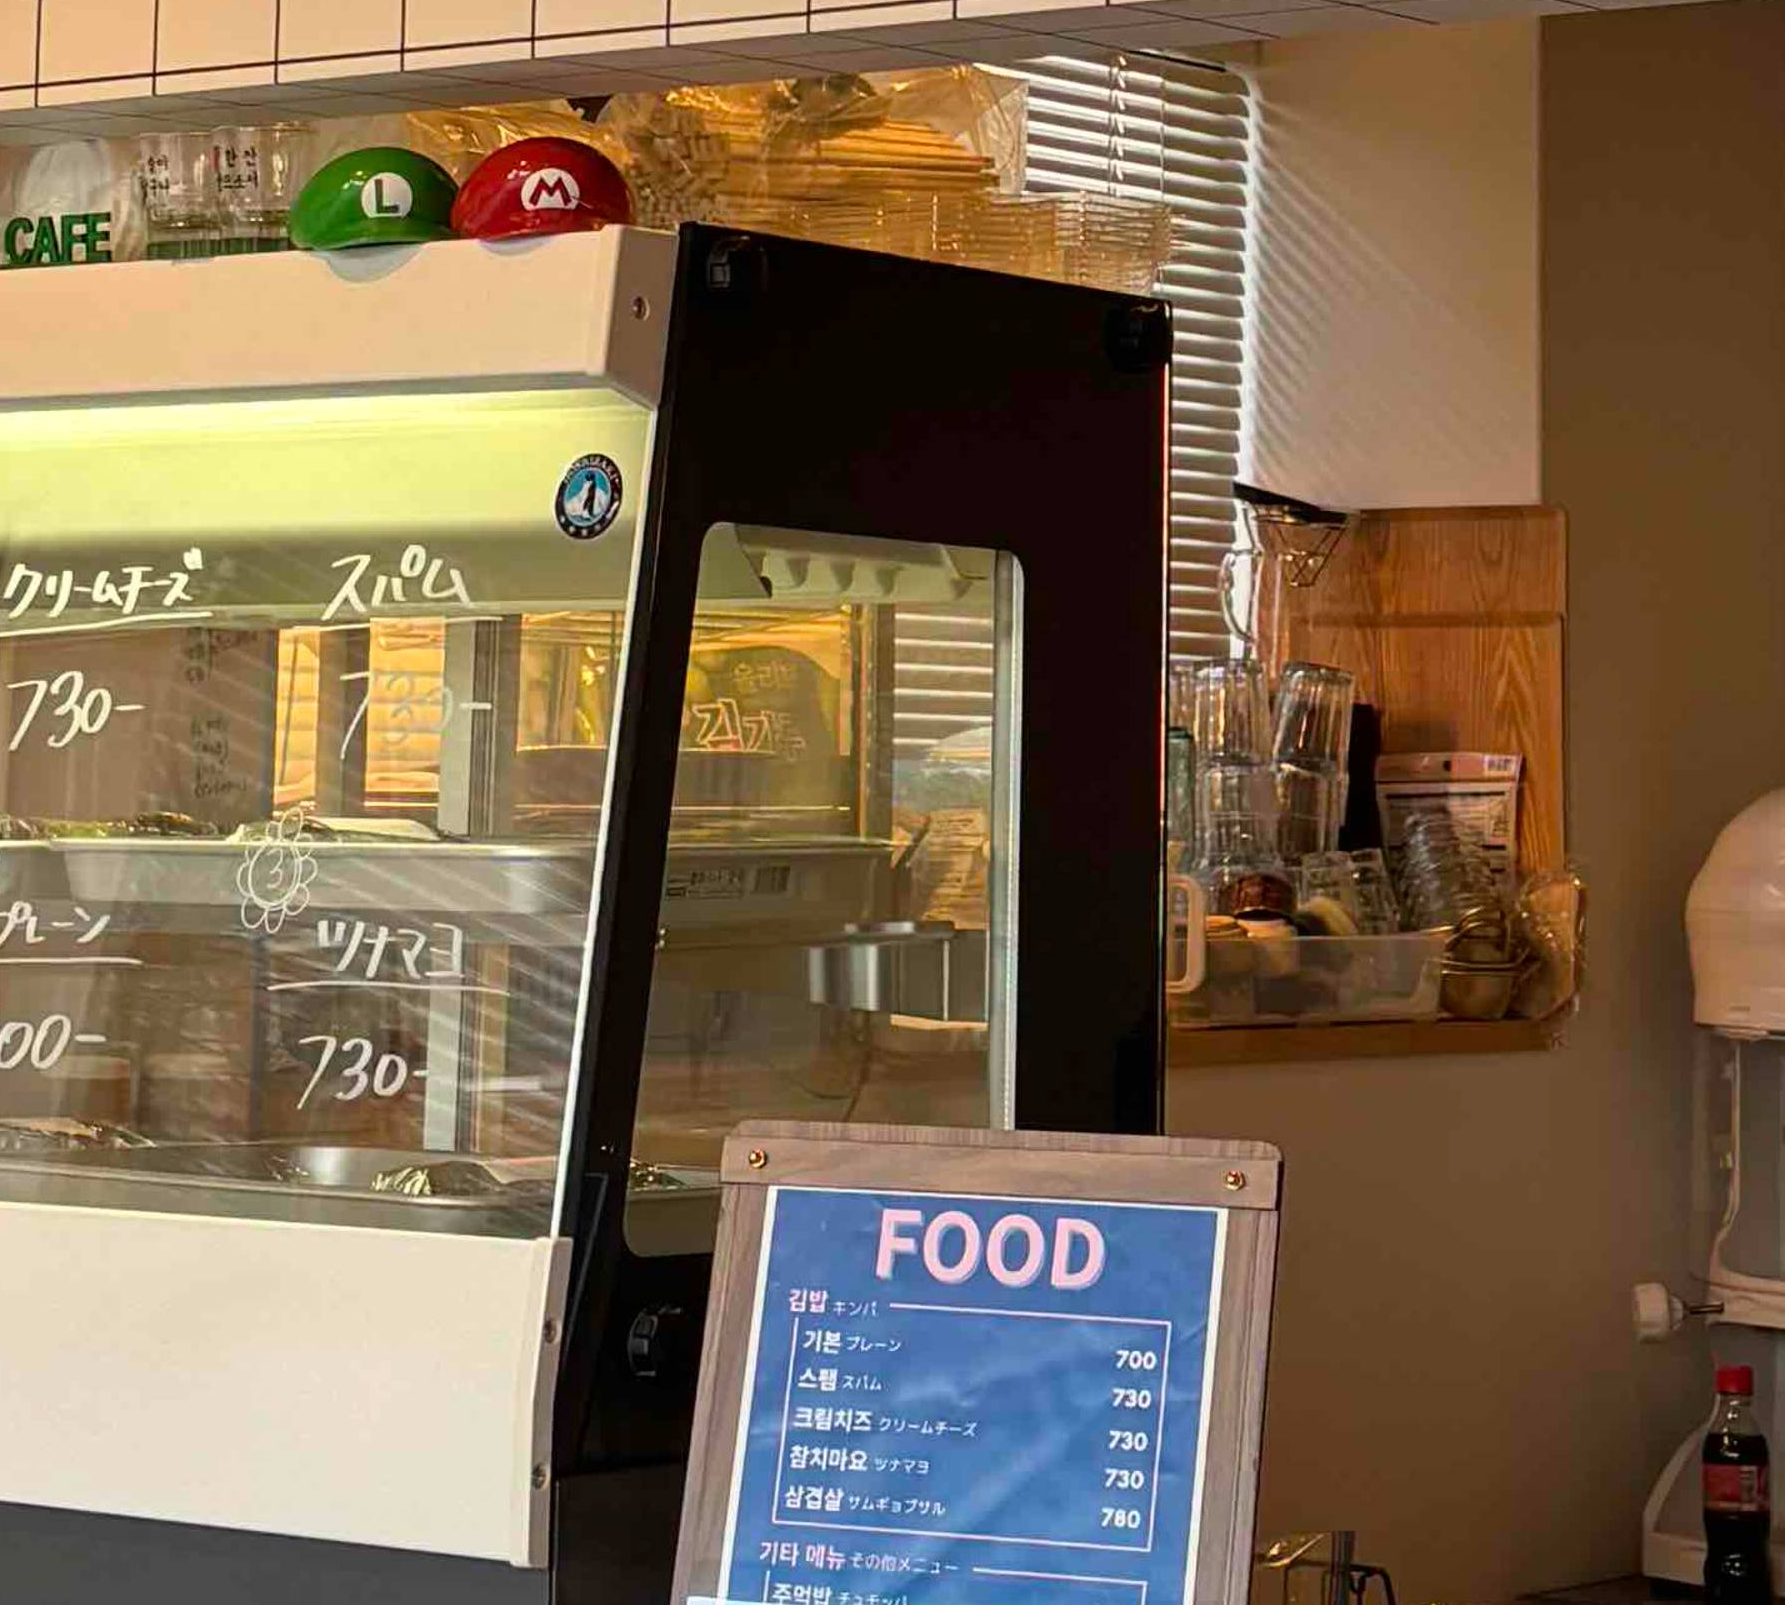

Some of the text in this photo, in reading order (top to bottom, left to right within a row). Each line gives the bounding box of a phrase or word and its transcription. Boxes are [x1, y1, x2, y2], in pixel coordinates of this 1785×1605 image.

[376, 179, 399, 215] L
[530, 175, 579, 210] M
[4, 211, 112, 267] CAFE
[2, 547, 205, 618] クリームチーズ
[321, 544, 473, 621] スパム
[7, 670, 145, 752] 730-
[318, 919, 465, 981] ツナマヨ
[297, 1034, 430, 1110] 730-
[875, 1208, 1106, 1289] FOOD
[789, 1289, 828, 1314] 김밥
[803, 1330, 841, 1354] 기본
[1115, 1350, 1157, 1371] 700
[798, 1368, 838, 1391] 스팸
[1112, 1389, 1152, 1409] 730
[792, 1407, 872, 1432] 크림치즈
[1108, 1431, 1148, 1452] 730
[790, 1445, 868, 1471] 참치마요
[1104, 1470, 1144, 1491] 730
[785, 1485, 845, 1512] 삼겹살
[1100, 1509, 1141, 1530] 780
[759, 1541, 800, 1566] 기타
[806, 1545, 846, 1571] 메뉴
